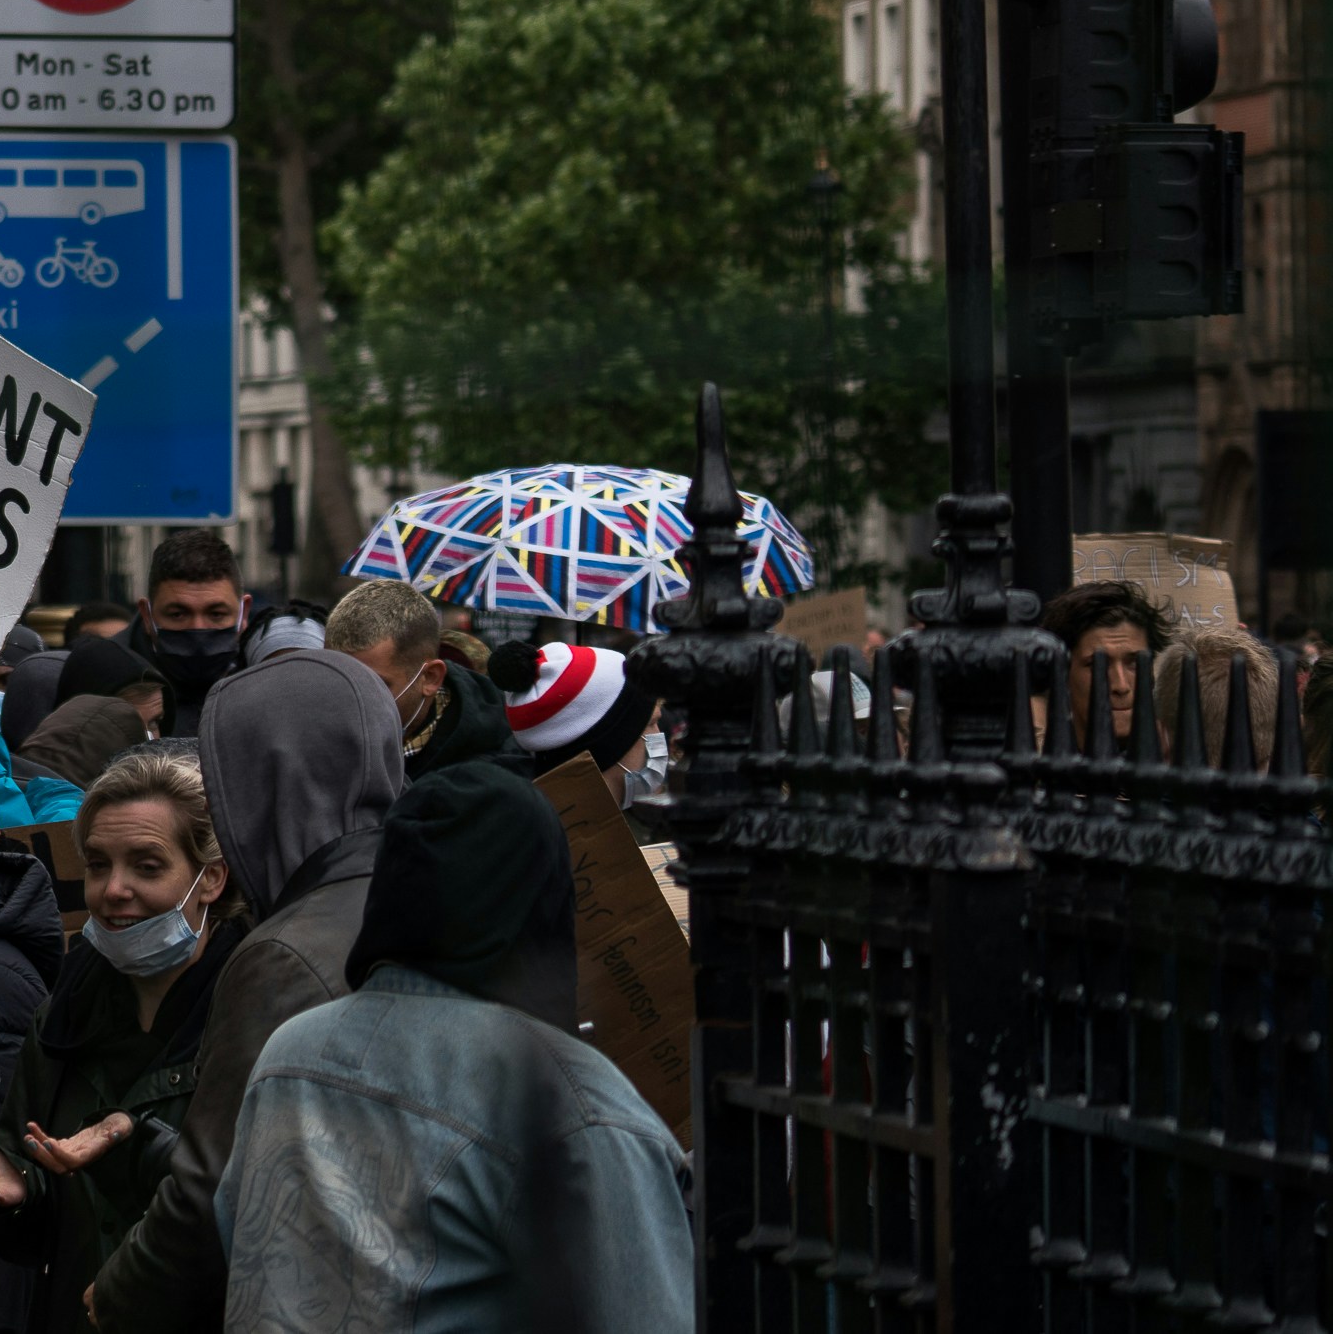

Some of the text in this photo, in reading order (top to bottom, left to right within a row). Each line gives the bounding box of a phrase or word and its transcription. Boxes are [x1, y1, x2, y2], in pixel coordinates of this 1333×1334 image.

[16, 52, 75, 77] Mon
[103, 51, 152, 77] Sat
[27, 92, 67, 112] am
[96, 87, 165, 113] 6.30
[174, 94, 216, 117] pm
